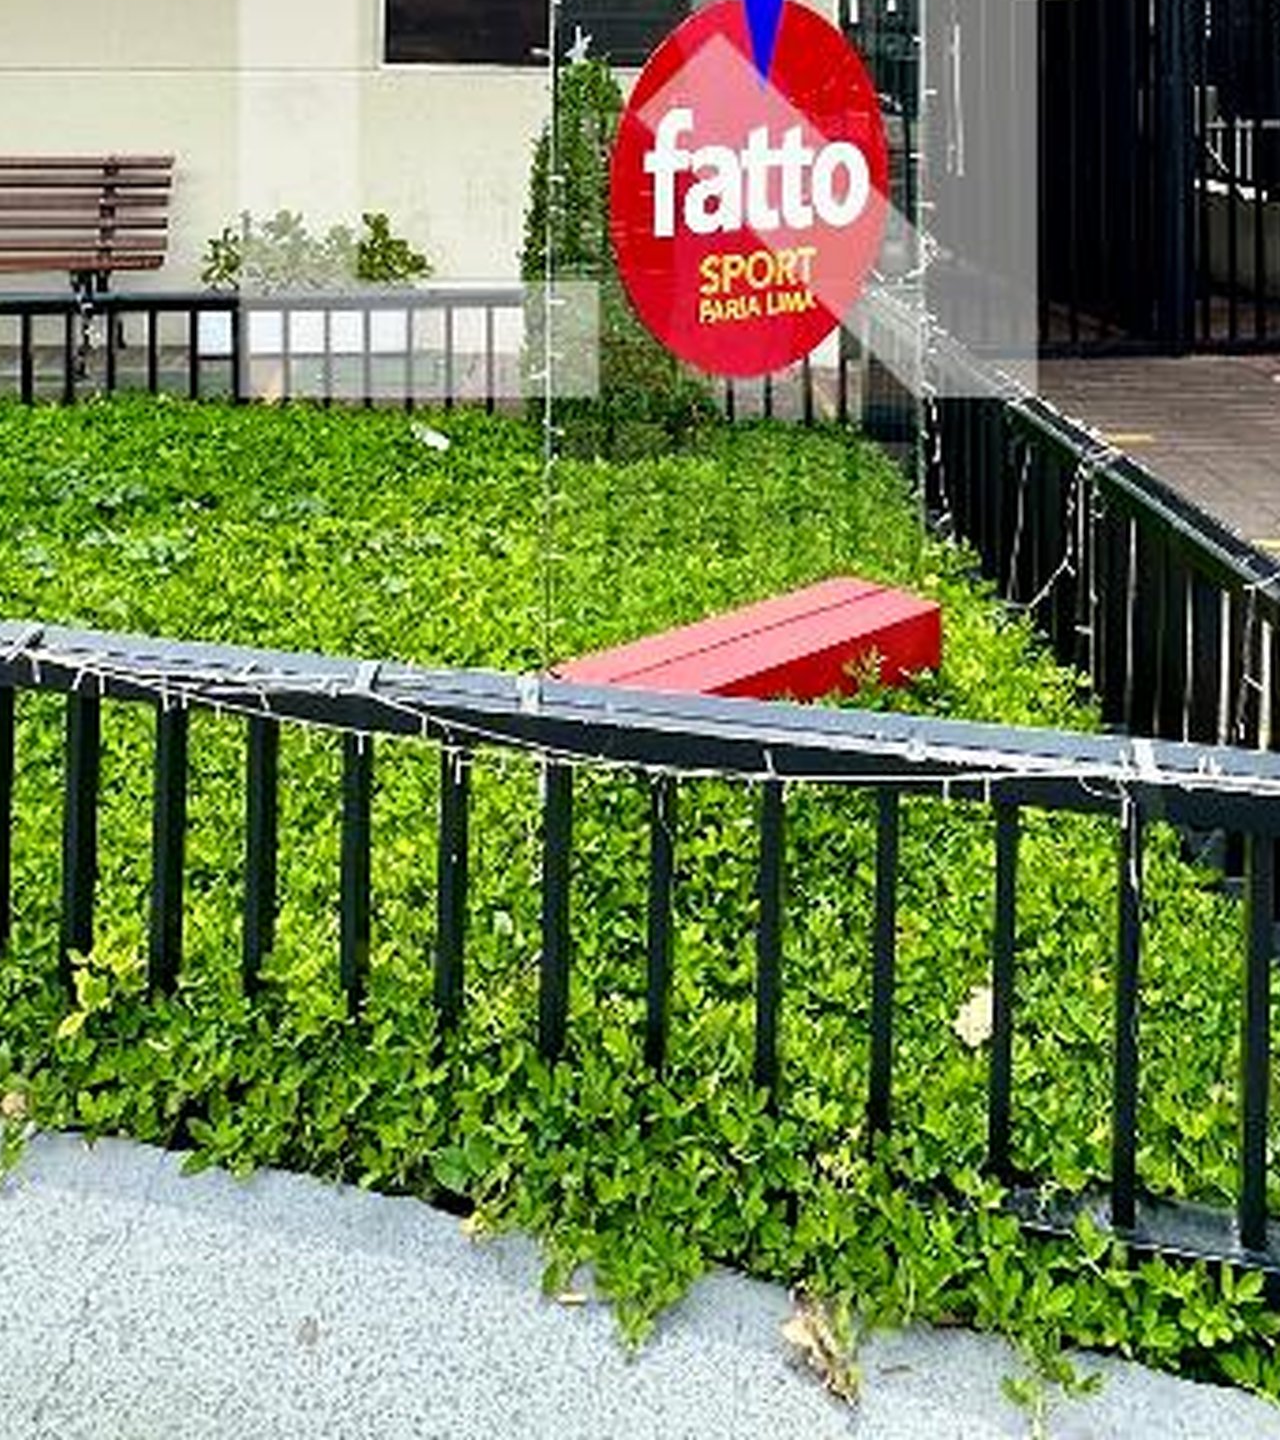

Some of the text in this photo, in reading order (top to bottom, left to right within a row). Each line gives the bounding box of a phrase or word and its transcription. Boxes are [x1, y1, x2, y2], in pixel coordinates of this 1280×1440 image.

[644, 108, 871, 238] fatto
[699, 246, 818, 294] SPORT
[699, 289, 818, 324] FARIA LIMA
